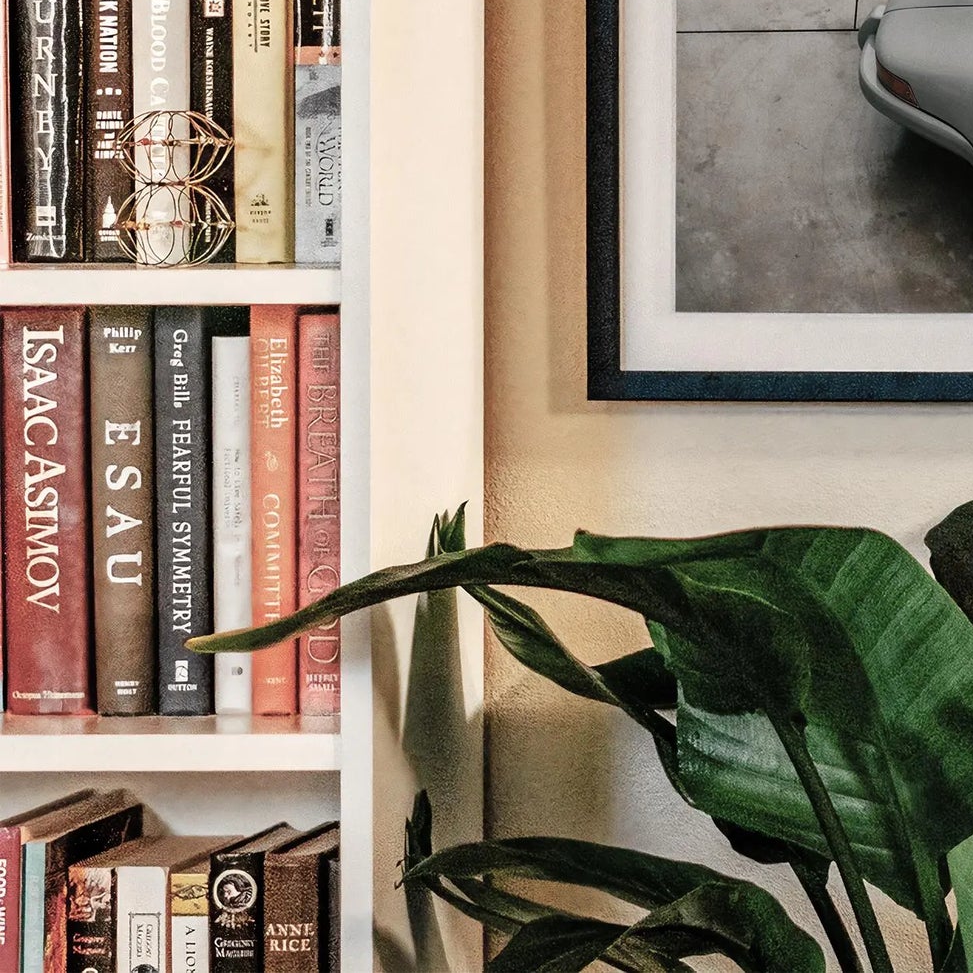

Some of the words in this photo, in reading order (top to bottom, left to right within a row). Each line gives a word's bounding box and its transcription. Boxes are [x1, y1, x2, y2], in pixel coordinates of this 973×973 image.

[99, 15, 118, 73] NATION
[259, 18, 271, 48] STORY
[318, 136, 337, 206] WORLD
[109, 342, 137, 354] Kerr
[169, 329, 189, 367] Greg
[269, 338, 289, 428] Elizabeth
[22, 325, 65, 446] ISAAC
[173, 373, 191, 408] Bills
[172, 418, 192, 514] FEARFUL
[307, 384, 338, 520] BREATH
[23, 450, 67, 614] ASIMOV
[105, 419, 143, 587] ESAU
[172, 521, 192, 635] SYMMETRY
[261, 493, 281, 625] COMMITTE
[185, 925, 196, 936] A
[265, 922, 315, 938] ANNE
[269, 938, 312, 953] RICE
